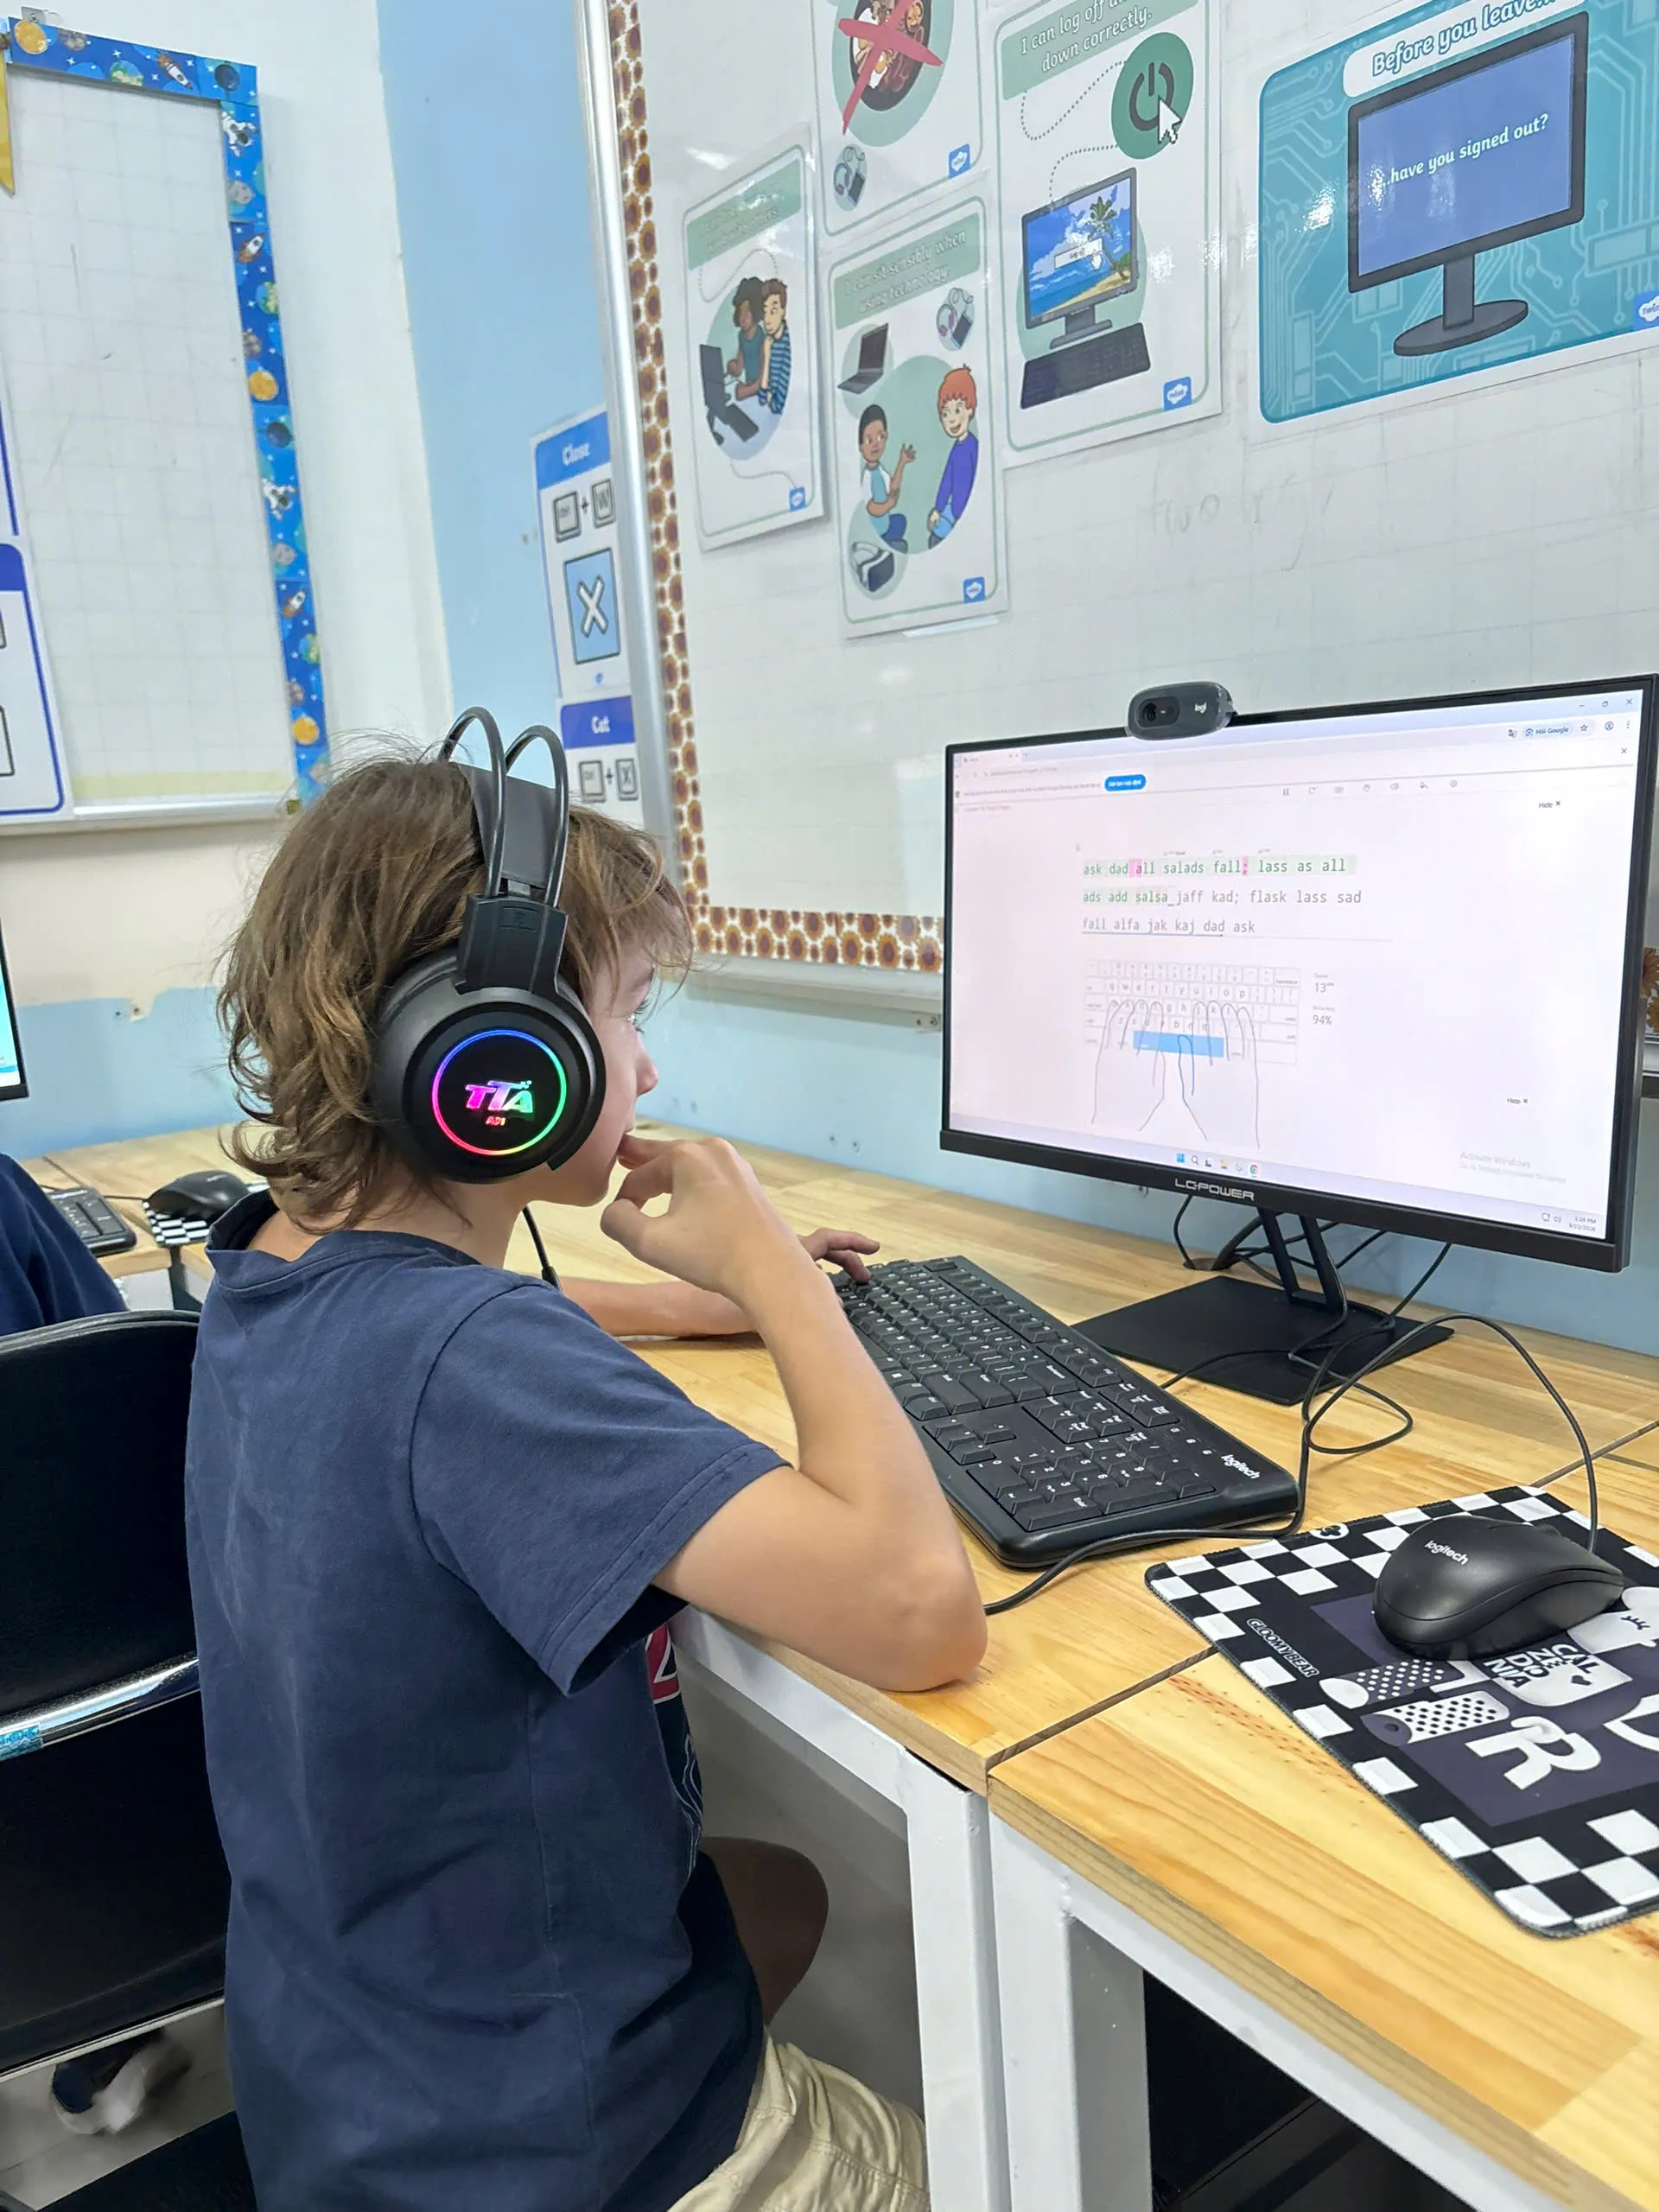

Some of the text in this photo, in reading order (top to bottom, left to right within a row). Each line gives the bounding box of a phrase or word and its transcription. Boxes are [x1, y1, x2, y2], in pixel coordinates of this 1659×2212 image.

[1021, 38, 1028, 55] I
[1031, 28, 1055, 50] can
[1059, 13, 1080, 34] log
[1085, 0, 1106, 23] off
[1041, 6, 1152, 72] down correctly.
[1372, 35, 1434, 77] Before
[1438, 17, 1477, 55] you
[1428, 150, 1455, 174] you
[1459, 126, 1509, 159] signed
[1514, 114, 1549, 139] out?
[562, 442, 590, 466] Close
[1194, 702, 1207, 713] logi
[591, 715, 611, 734] Cut
[1548, 726, 1569, 734] Google
[1084, 858, 1346, 875] ask dad all salads fall; lass as all
[1083, 891, 1101, 902] ads
[1108, 891, 1128, 902] add
[1212, 891, 1239, 905] kad;
[1250, 890, 1287, 903] flask
[1296, 890, 1327, 903] lass
[1337, 890, 1362, 903] sad
[1083, 918, 1255, 934] fall alfa jak kaj dad ask
[1313, 1015, 1332, 1025] 94%
[1221, 1454, 1260, 1479] logitech
[1424, 1540, 1469, 1565] logitech
[1247, 1618, 1320, 1678] GLOOMY BEAR
